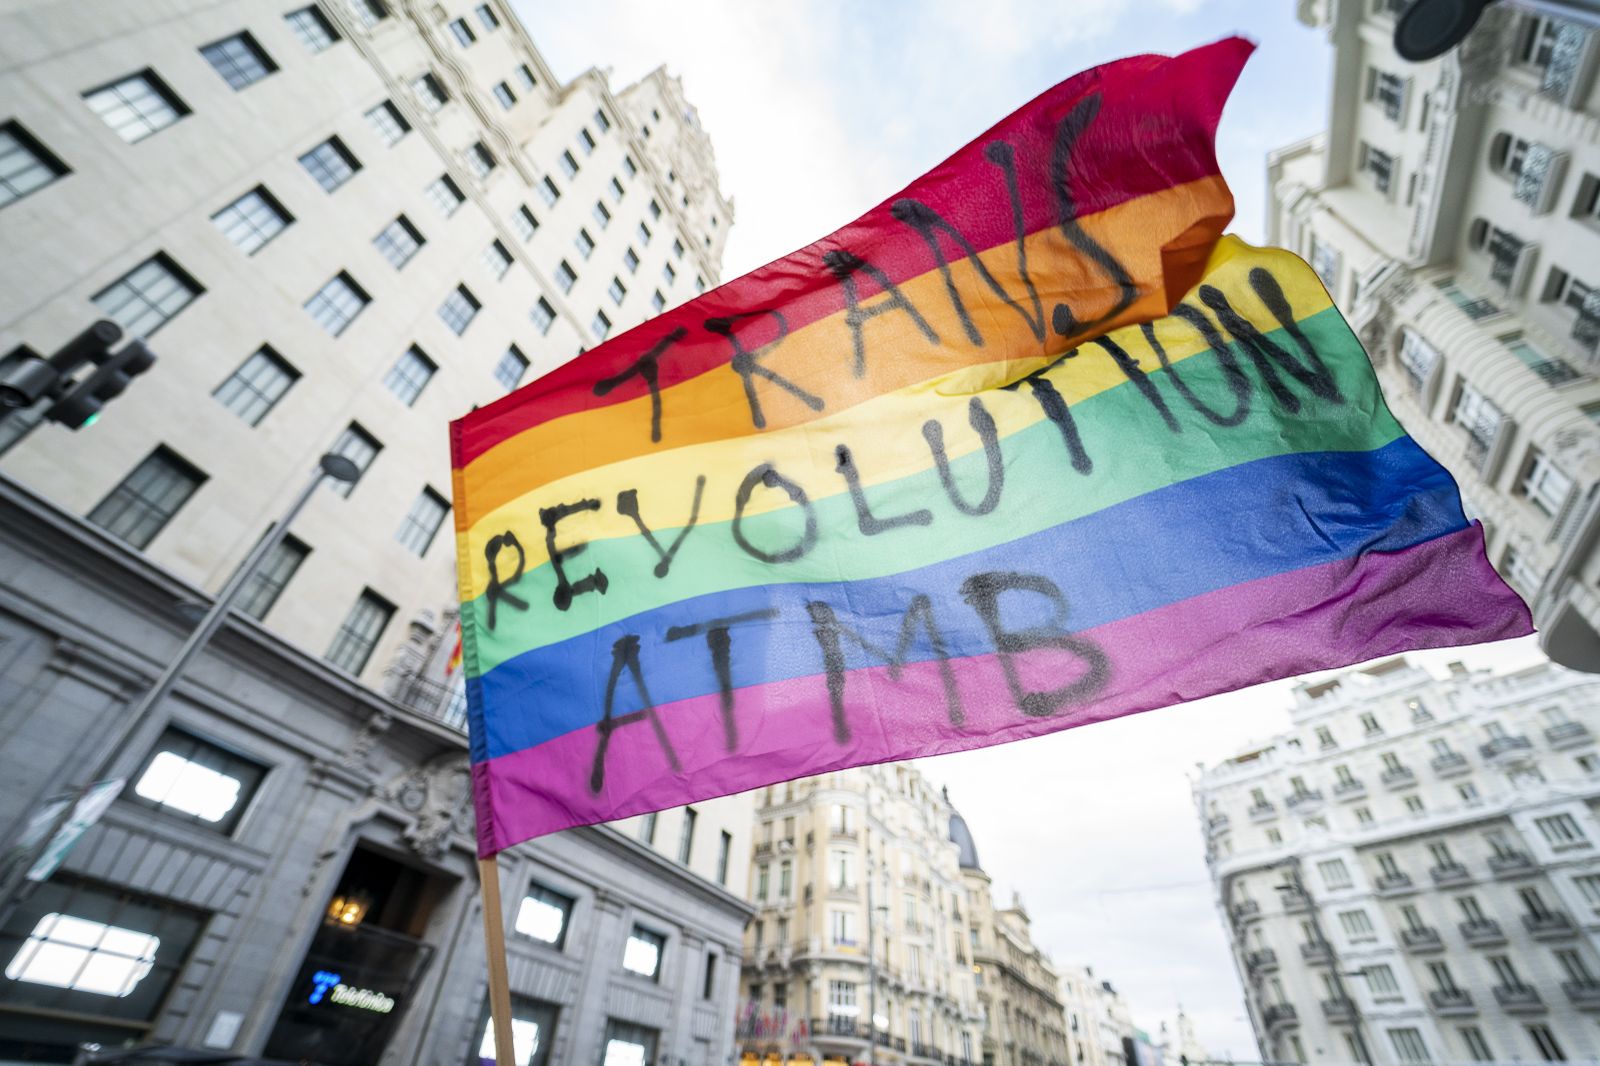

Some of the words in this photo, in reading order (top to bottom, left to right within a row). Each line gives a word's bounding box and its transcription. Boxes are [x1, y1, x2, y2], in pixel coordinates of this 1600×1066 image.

[593, 93, 1139, 443] TRANS
[483, 267, 1346, 632] REVOLUTION
[589, 571, 1112, 795] ATMB
